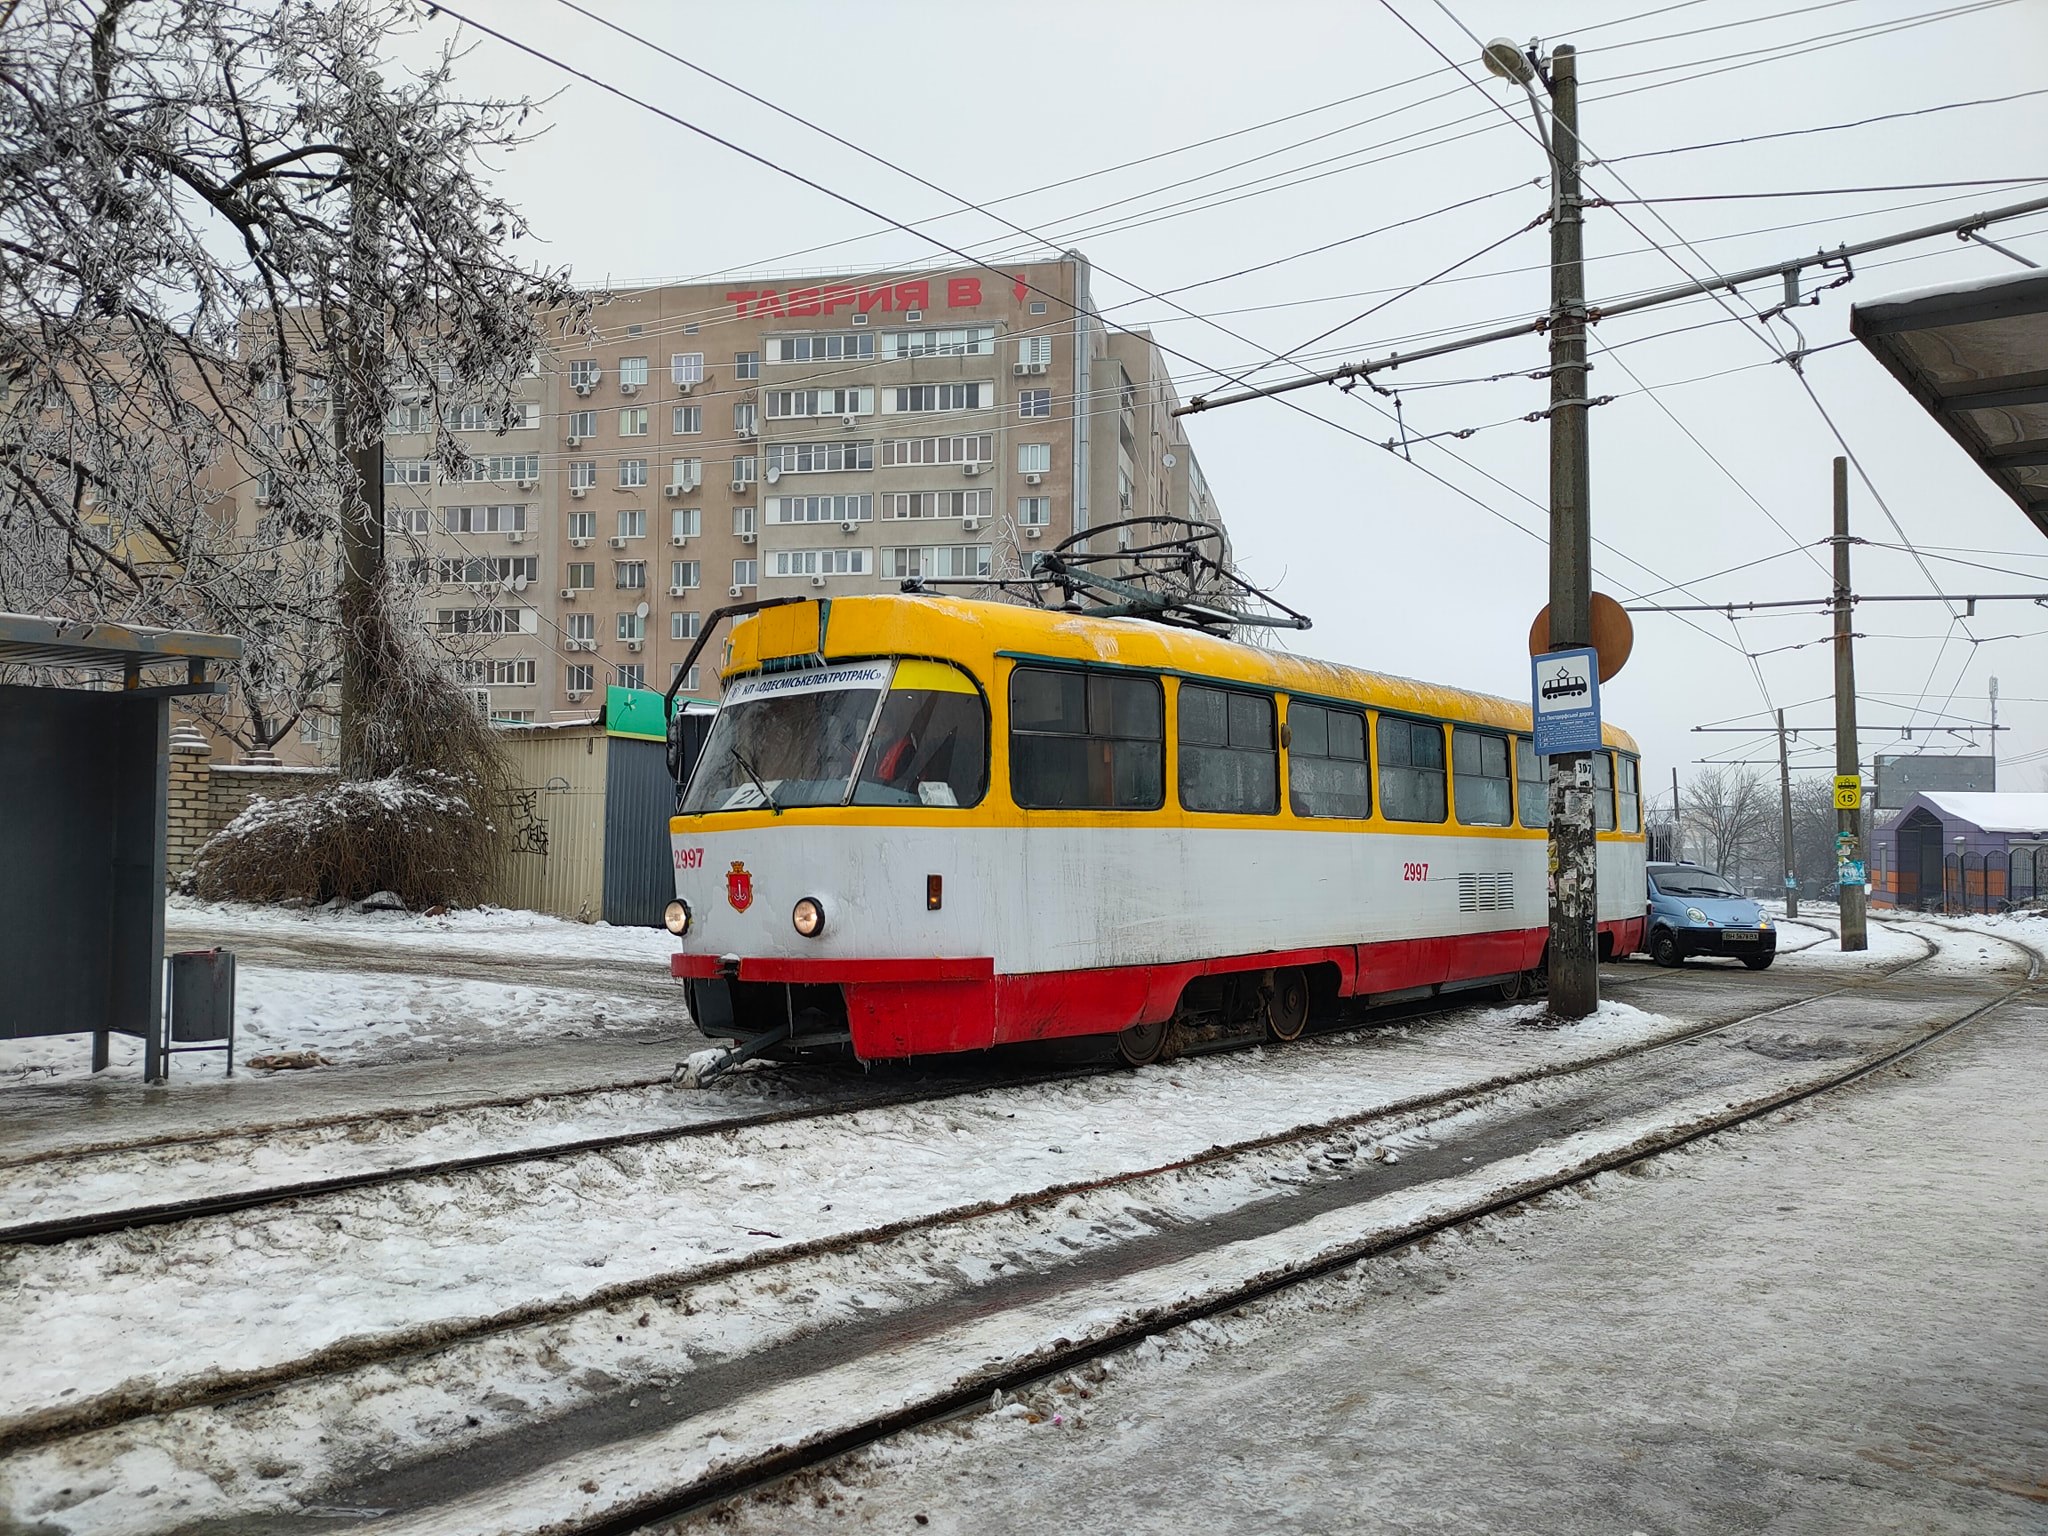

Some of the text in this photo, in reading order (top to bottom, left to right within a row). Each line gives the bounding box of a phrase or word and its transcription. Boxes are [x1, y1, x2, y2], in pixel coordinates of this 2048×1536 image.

[726, 277, 983, 319] ТАВРИЯ В
[742, 684, 755, 696] КП
[1577, 762, 1592, 774] 307
[1841, 794, 1853, 803] 15
[674, 848, 705, 869] 2997
[1403, 862, 1429, 882] 2997
